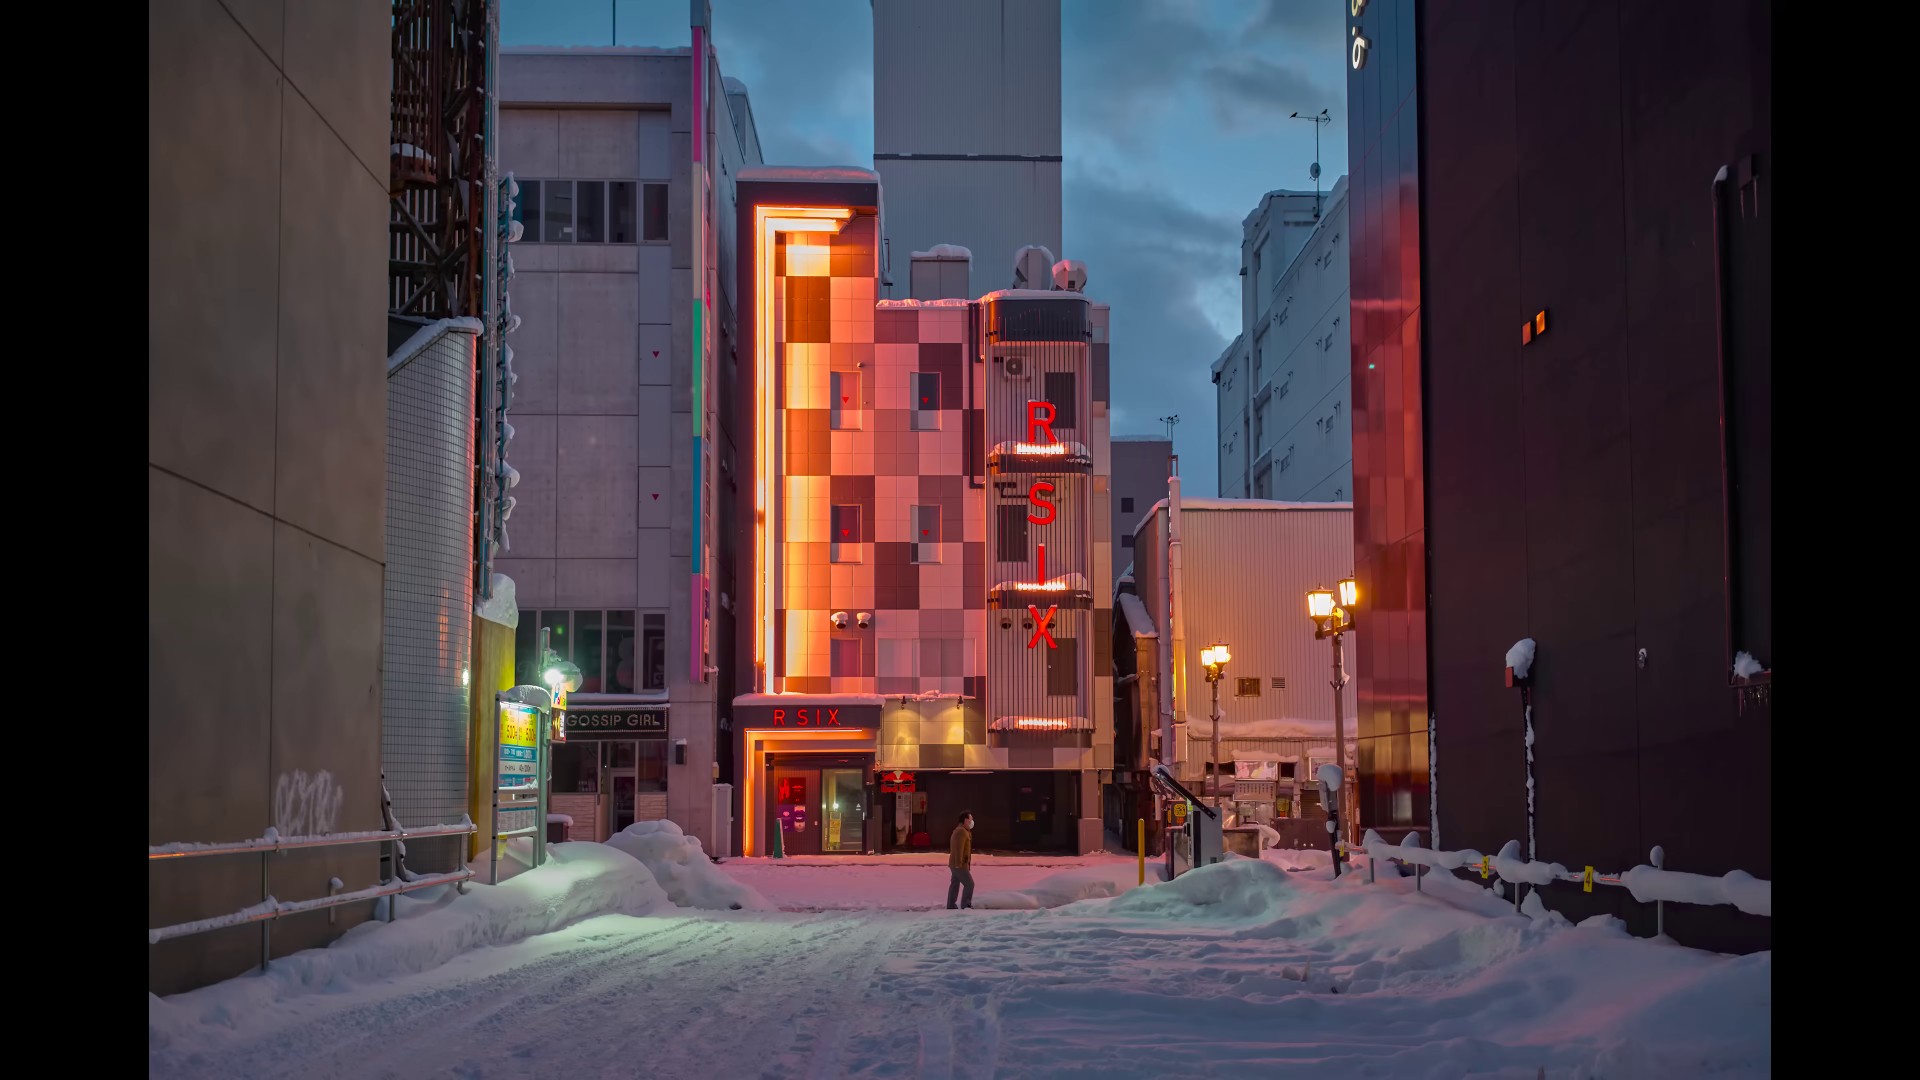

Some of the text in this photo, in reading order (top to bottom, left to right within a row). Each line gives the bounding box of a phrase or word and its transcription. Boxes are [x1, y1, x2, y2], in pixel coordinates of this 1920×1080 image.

[566, 714, 622, 727] GOSSIP
[627, 713, 660, 727] GIRL
[797, 709, 838, 726] SIX
[1586, 872, 1591, 887] 4
